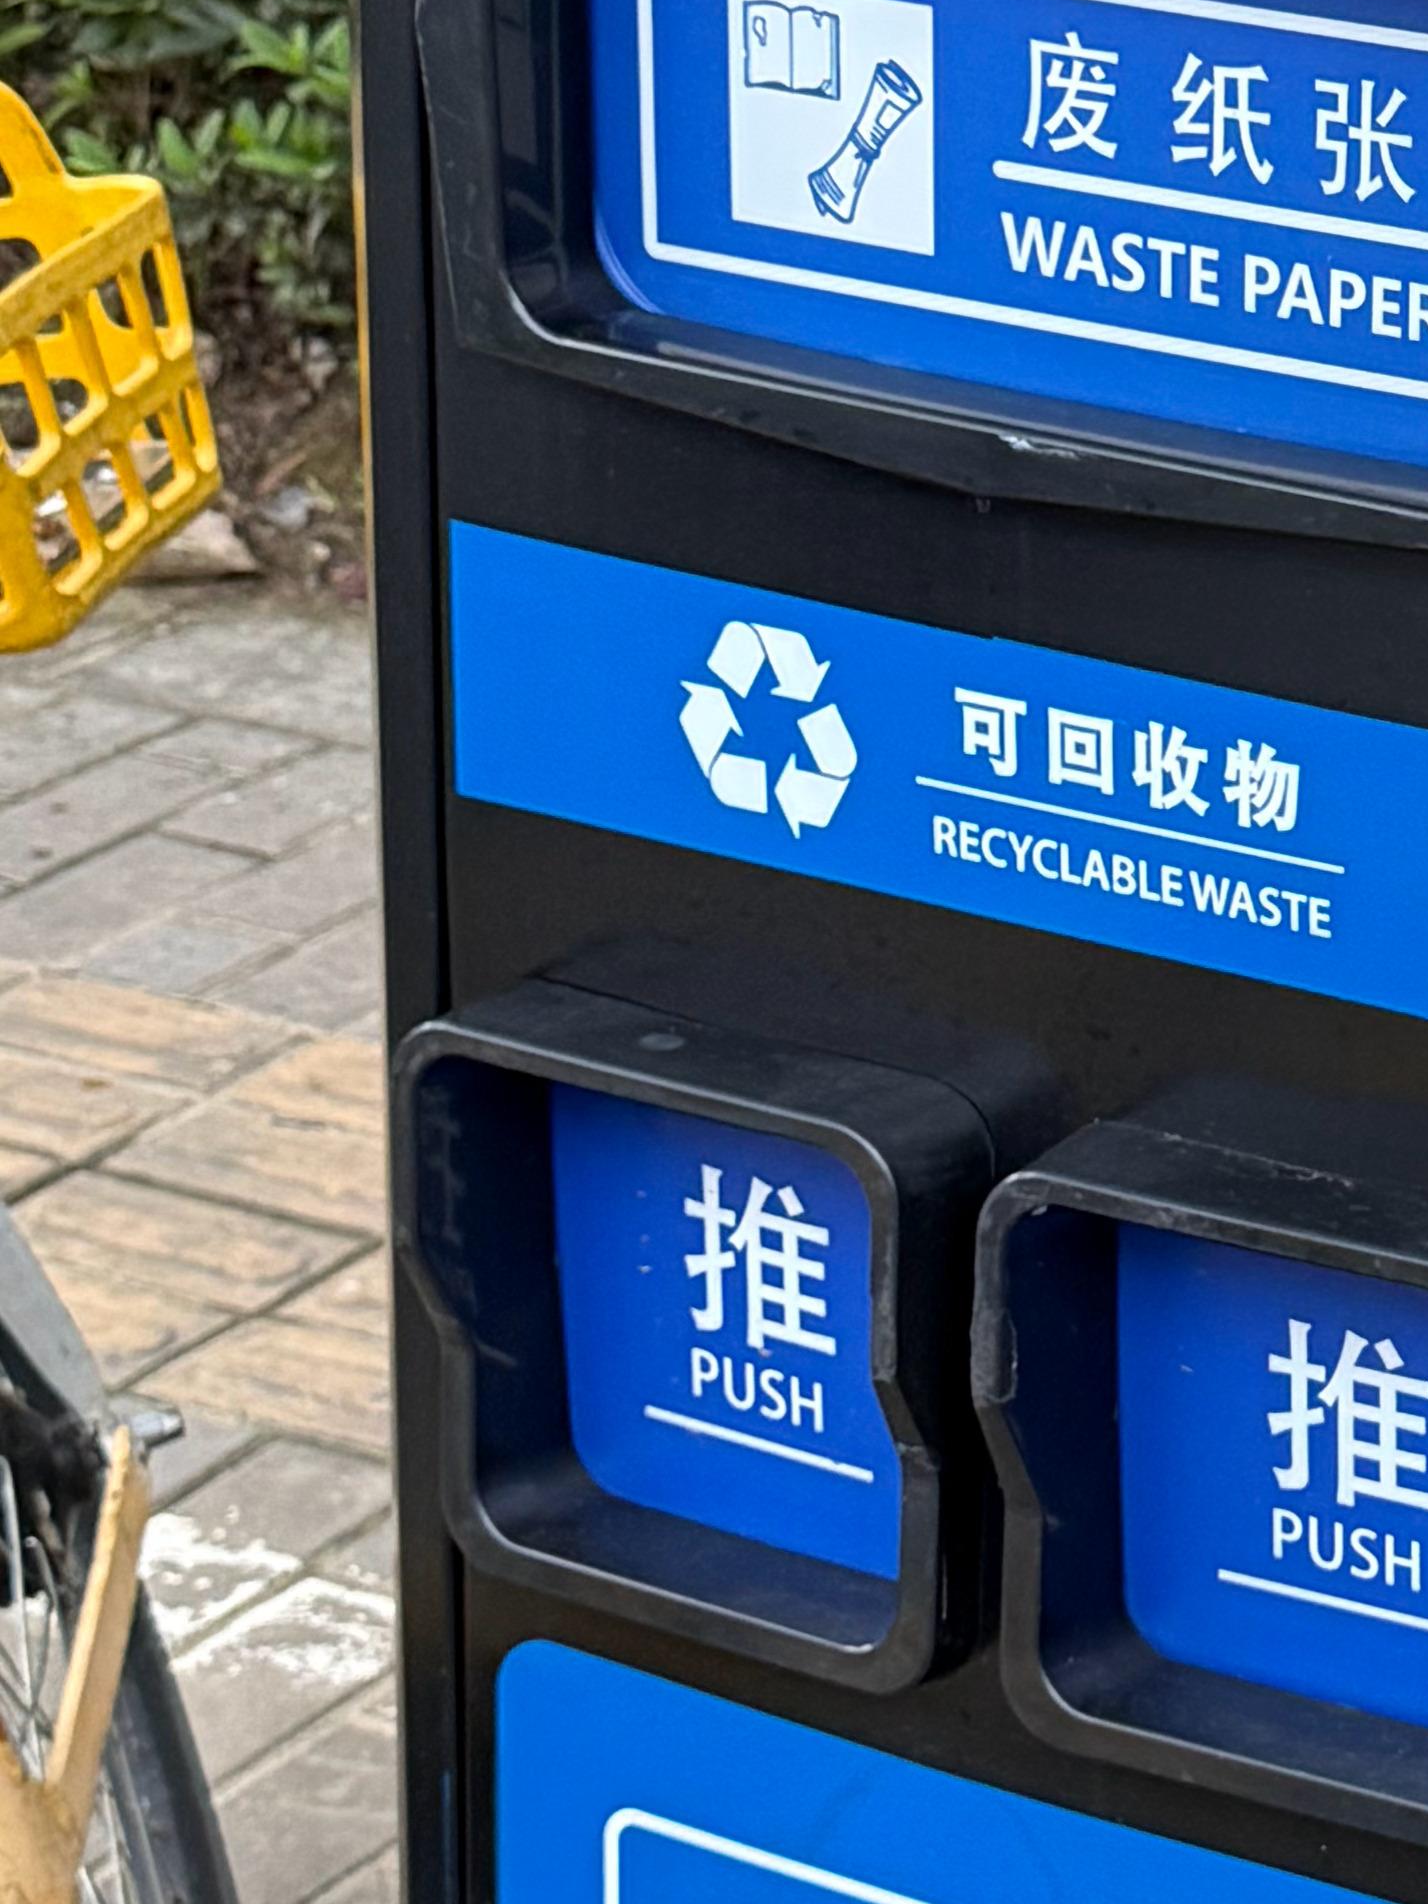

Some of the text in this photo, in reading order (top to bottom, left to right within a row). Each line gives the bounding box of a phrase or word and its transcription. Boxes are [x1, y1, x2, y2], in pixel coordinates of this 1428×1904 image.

[1020, 30, 1416, 204] 废纸张
[1000, 210, 1220, 308] WASTE
[953, 686, 1301, 832] 可回收物
[932, 815, 1332, 939] RECYCLABLE WASTE
[684, 1164, 837, 1356] 推
[691, 1347, 824, 1432] PUSH
[1272, 1508, 1421, 1592] PUSH
